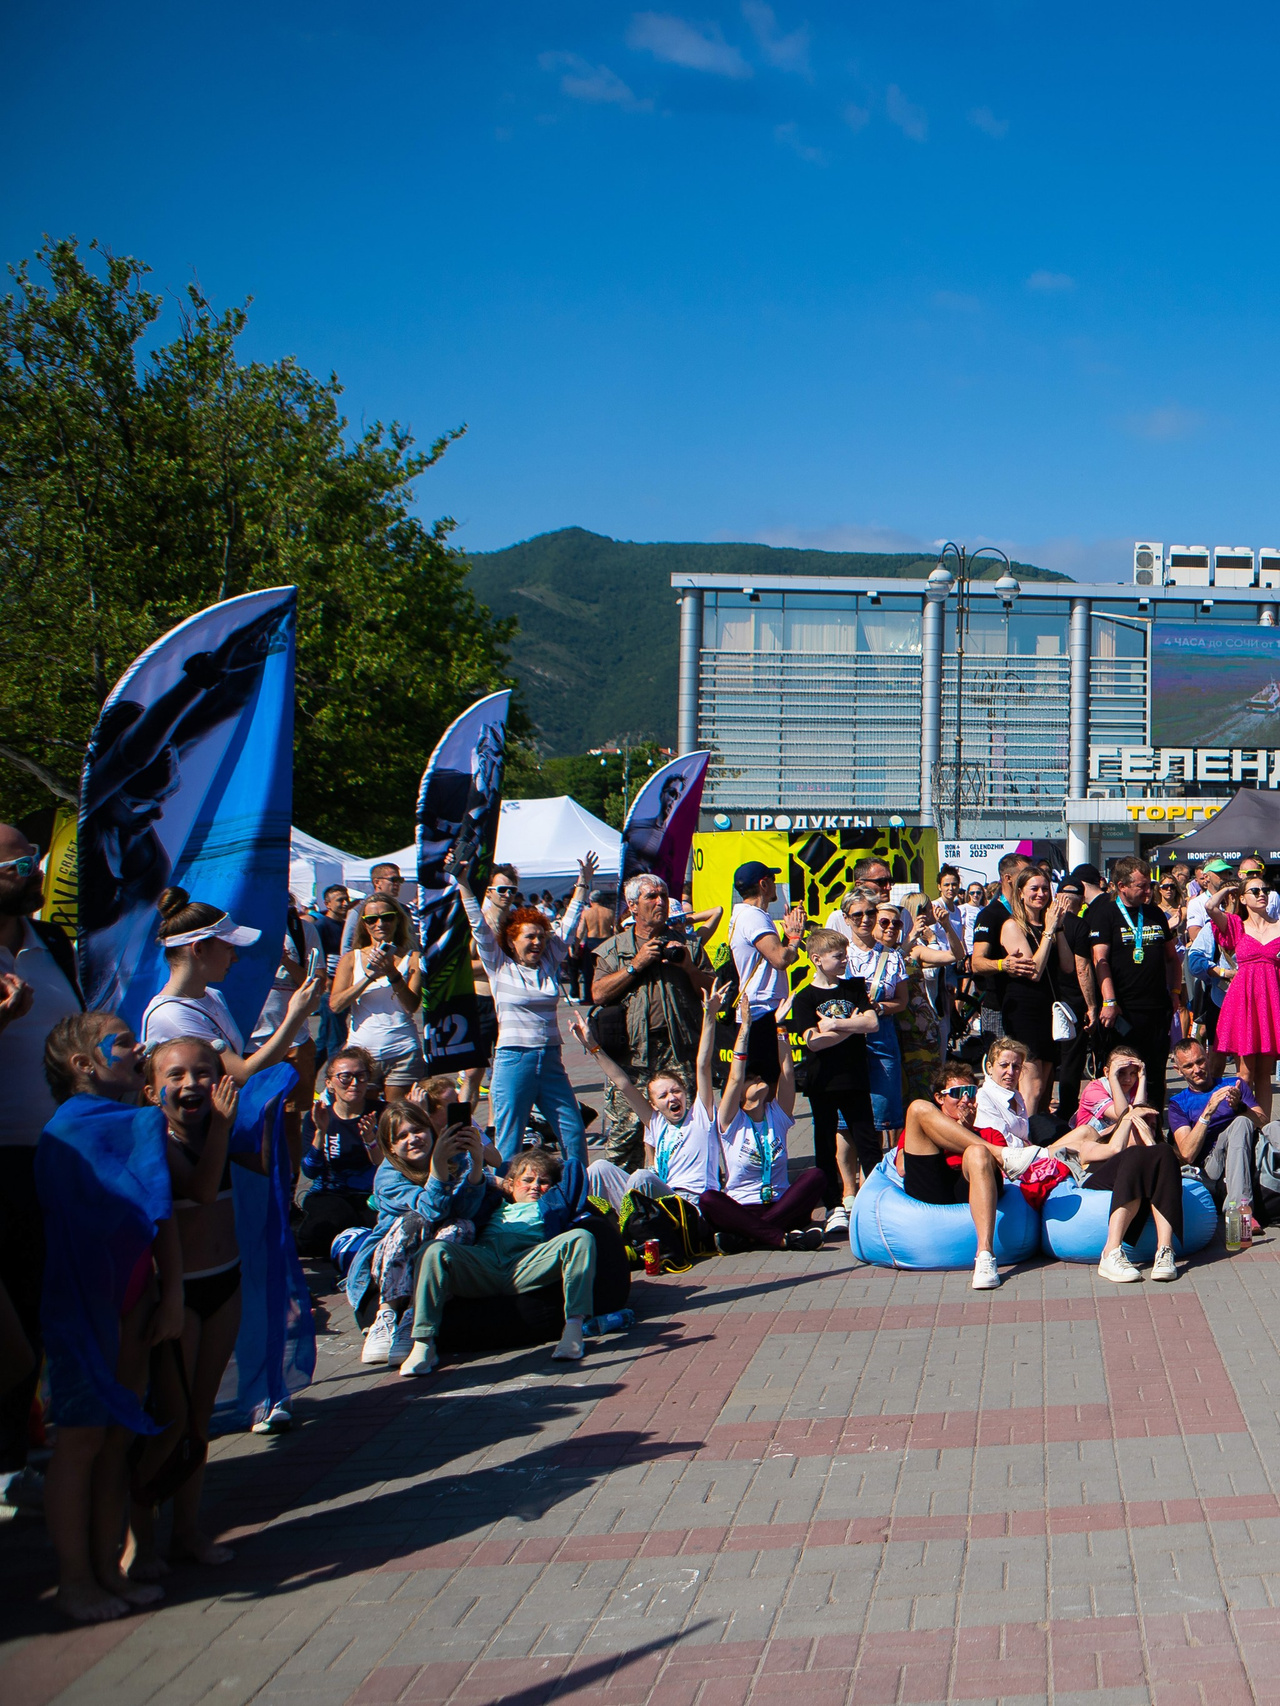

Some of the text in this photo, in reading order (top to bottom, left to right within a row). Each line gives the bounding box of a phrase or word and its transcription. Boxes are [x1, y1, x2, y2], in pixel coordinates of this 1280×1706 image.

[1164, 638, 1172, 646] 4
[1174, 637, 1206, 647] ЧАСА
[1208, 640, 1223, 648] до
[1225, 638, 1259, 648] СОЧИ
[1127, 805, 1223, 820] ТОРГО
[969, 849, 988, 858] 2023
